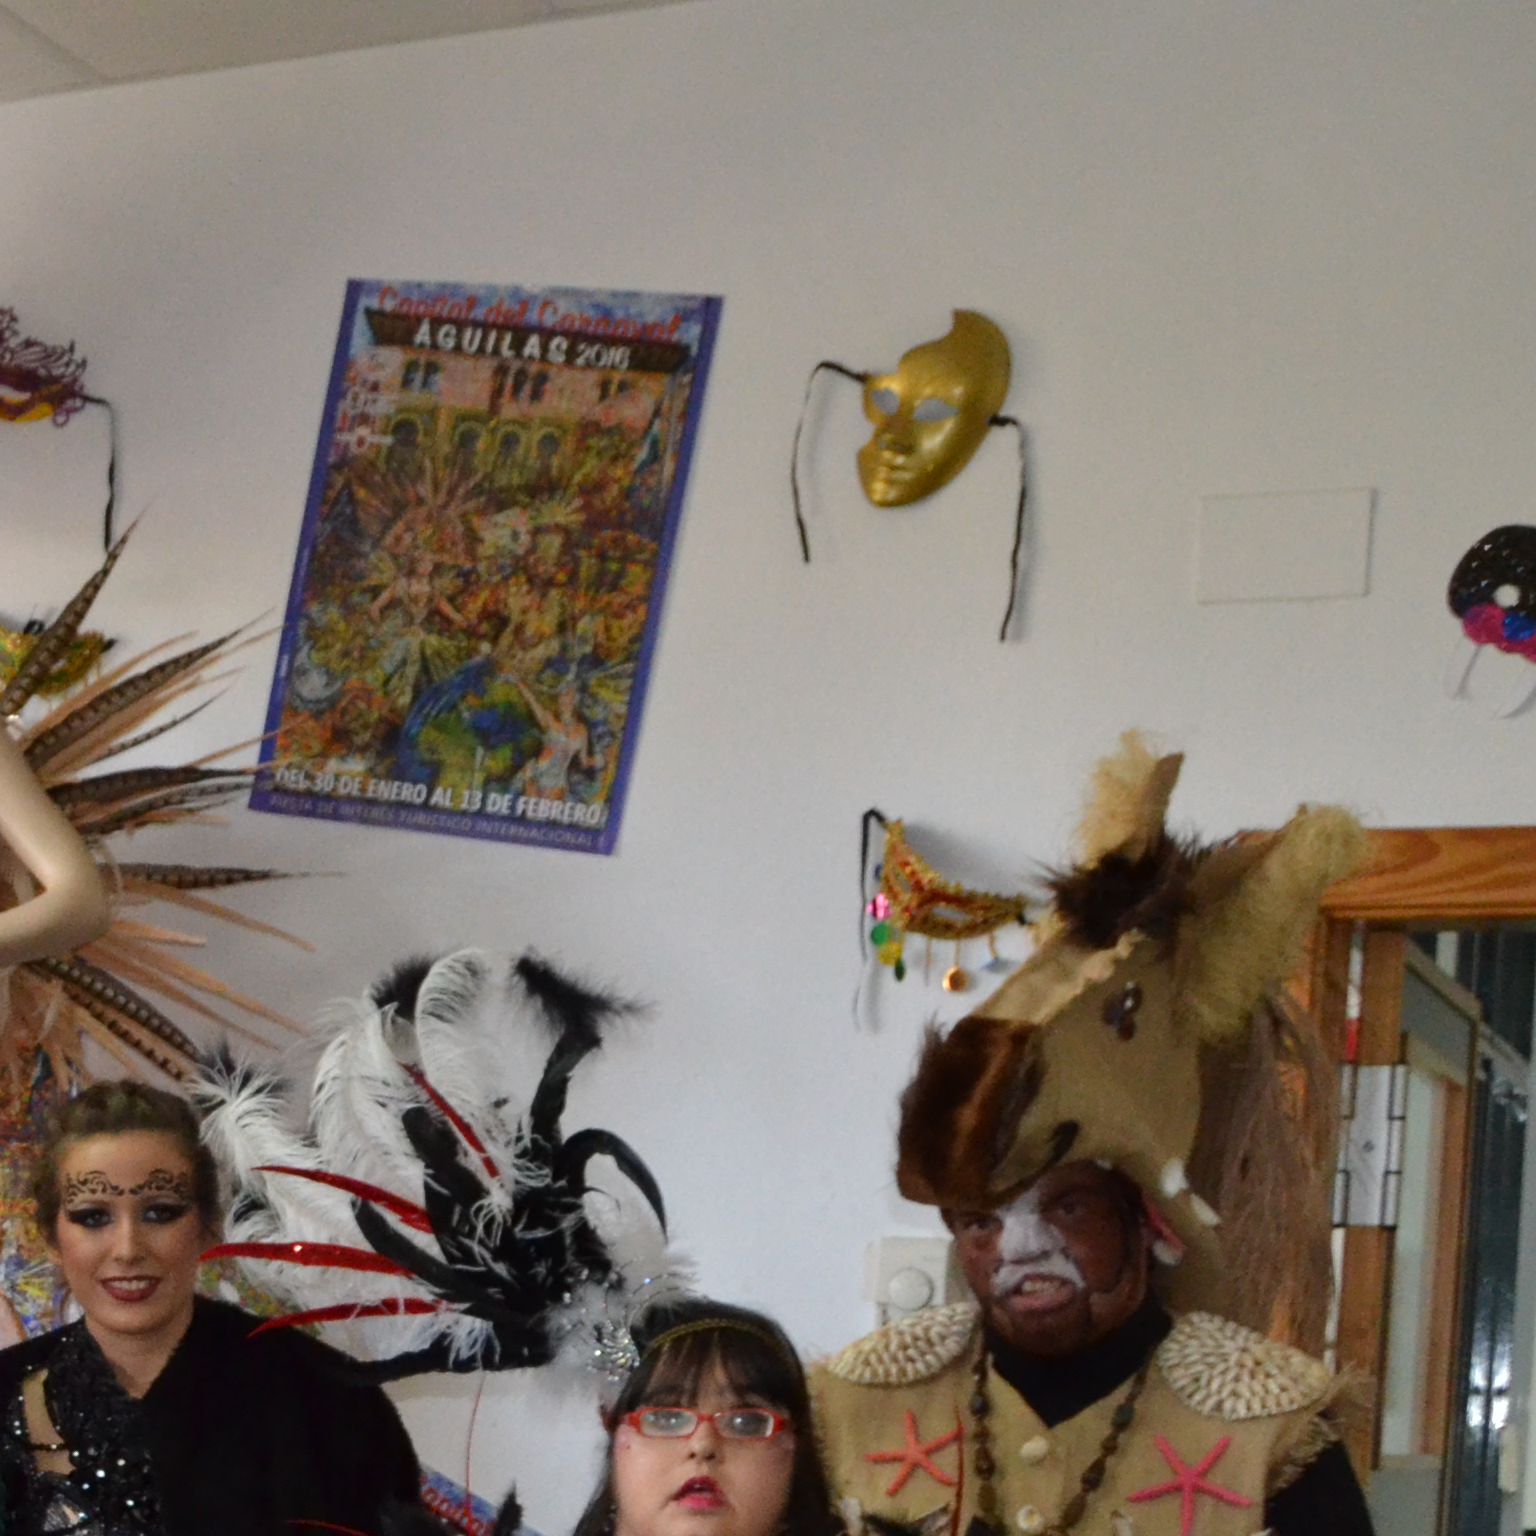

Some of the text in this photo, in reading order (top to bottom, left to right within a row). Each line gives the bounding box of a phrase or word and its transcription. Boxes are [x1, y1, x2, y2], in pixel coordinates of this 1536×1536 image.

[485, 297, 529, 325] del
[537, 298, 681, 342] Carnaval
[574, 342, 631, 370] 2016
[274, 767, 601, 826] DEL 30 DE ENERO AL 13 DE FEBRERO
[317, 801, 335, 814] DE
[476, 819, 594, 847] INTERNACIONAL
